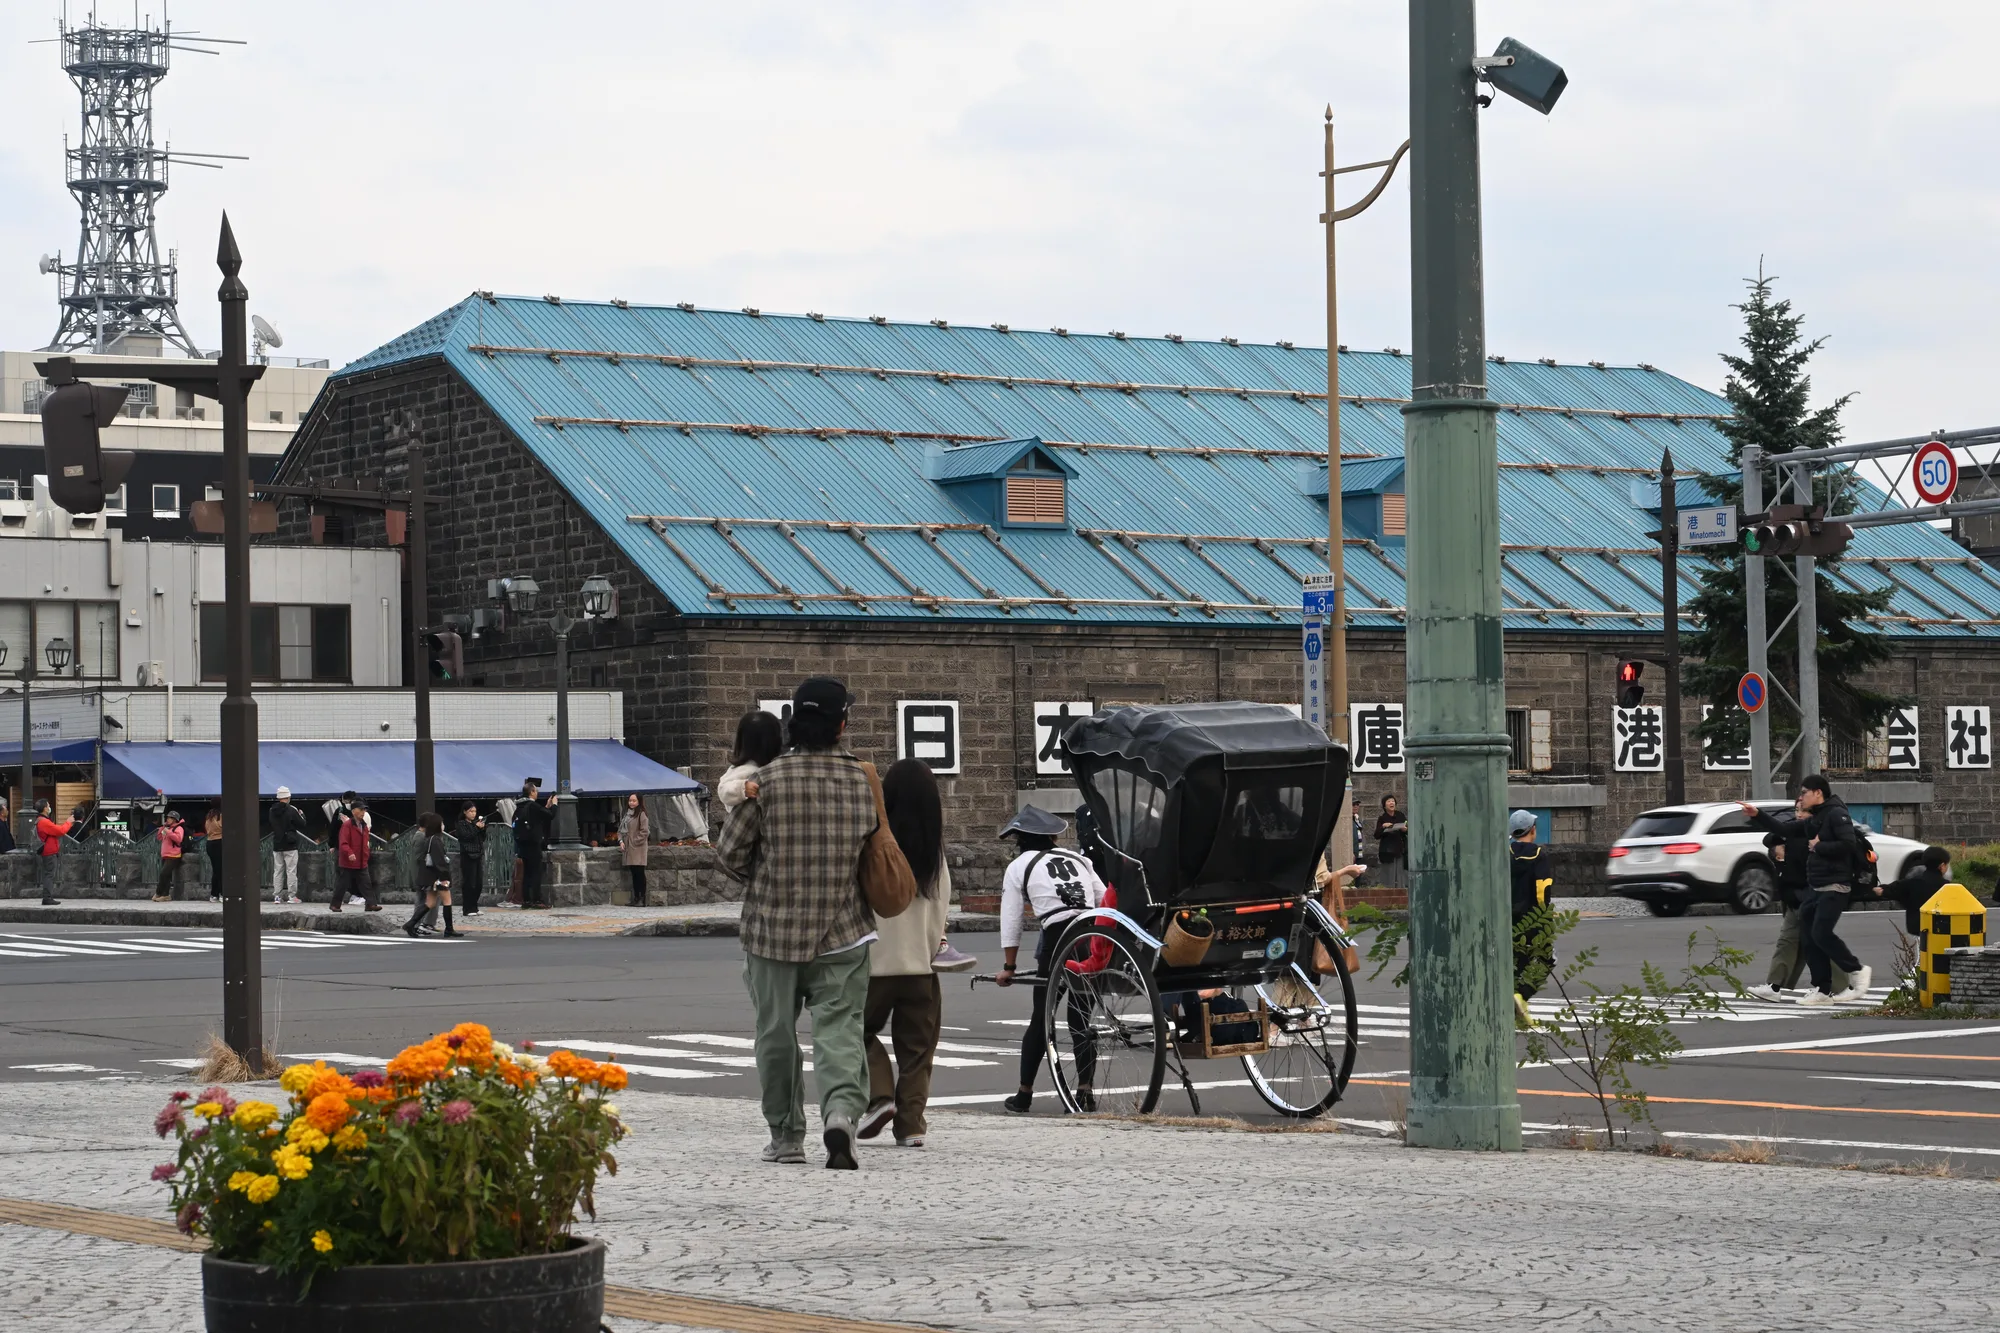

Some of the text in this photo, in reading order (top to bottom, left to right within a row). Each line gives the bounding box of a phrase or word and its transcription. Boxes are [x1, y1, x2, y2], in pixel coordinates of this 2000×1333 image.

[1922, 459, 1947, 487] 50
[1687, 512, 1727, 530] 港町
[1689, 529, 1726, 539] Minatomachi
[1308, 641, 1318, 653] 17
[903, 705, 956, 769] 日
[1037, 703, 1090, 771] 本
[1354, 704, 1403, 769] 庫
[1617, 707, 1661, 767] 港
[1949, 709, 1990, 765] 社
